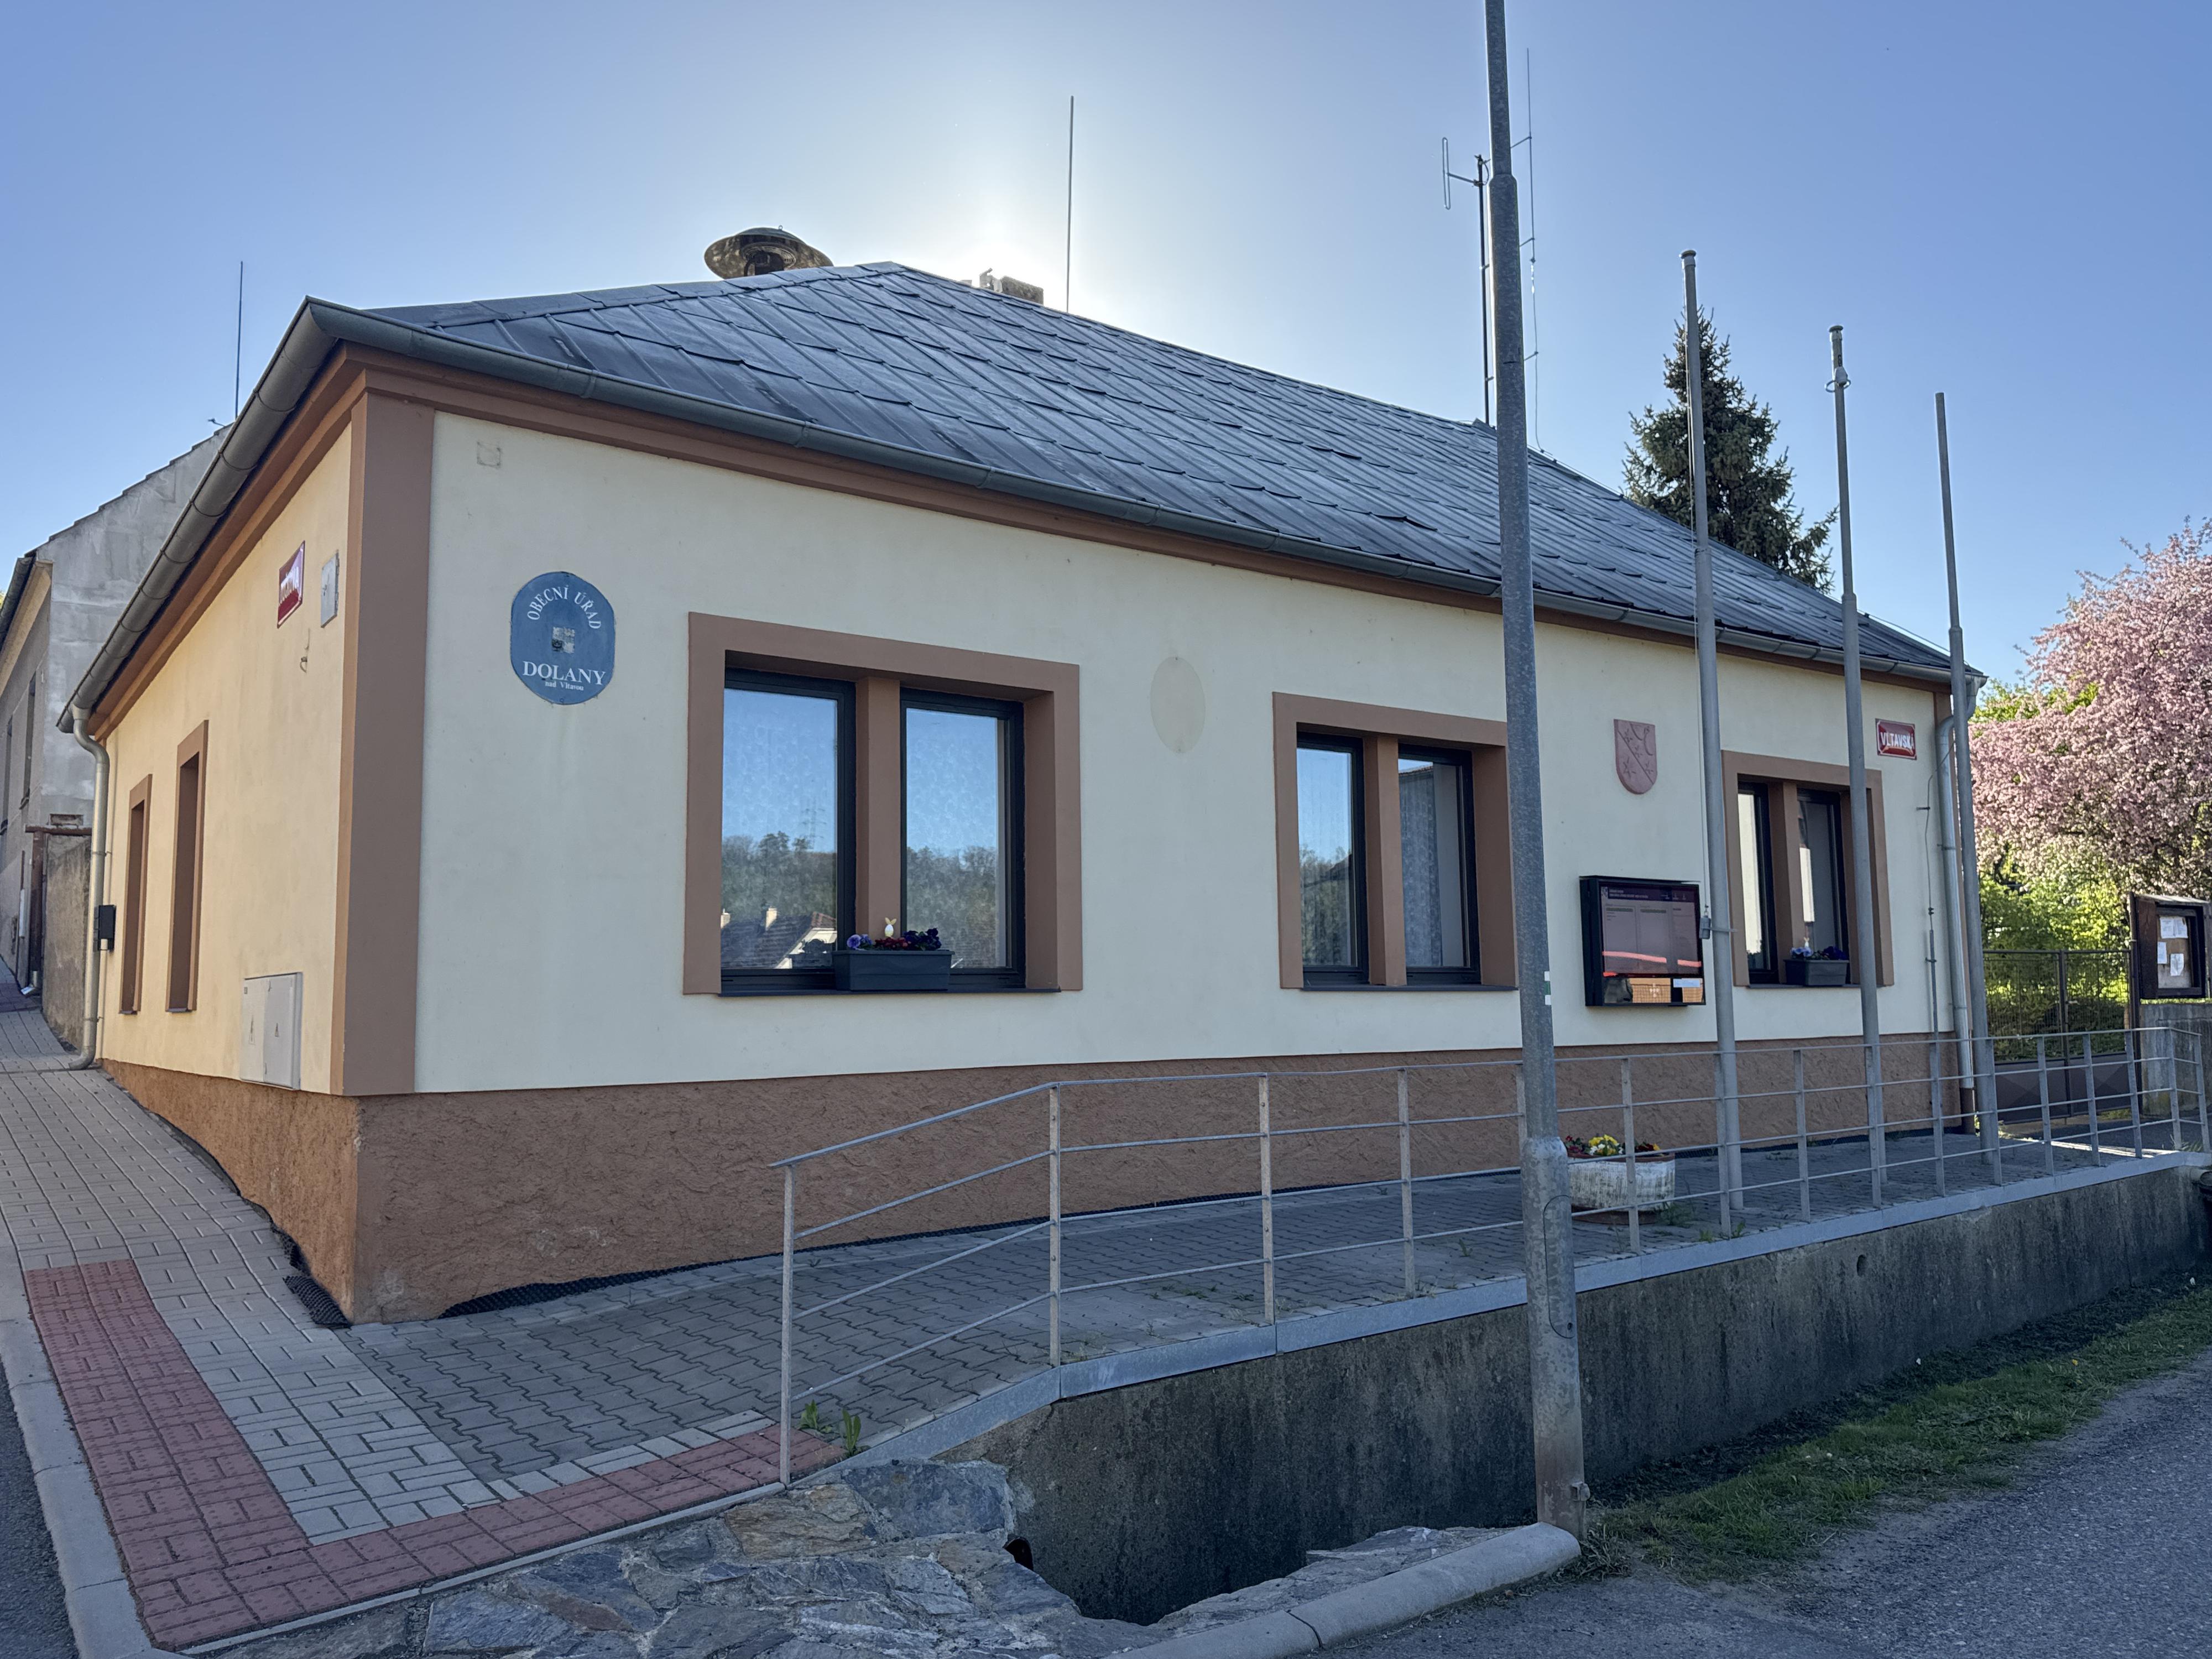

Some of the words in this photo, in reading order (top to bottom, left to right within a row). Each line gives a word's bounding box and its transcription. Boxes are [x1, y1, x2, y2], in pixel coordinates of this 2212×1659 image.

[527, 585, 569, 620] OBECNÍ
[574, 592, 602, 629] ÚŘAD
[522, 661, 606, 685] DOLANY
[560, 681, 584, 691] Vltavou
[1880, 732, 1914, 750] VLTAVSKÁ
